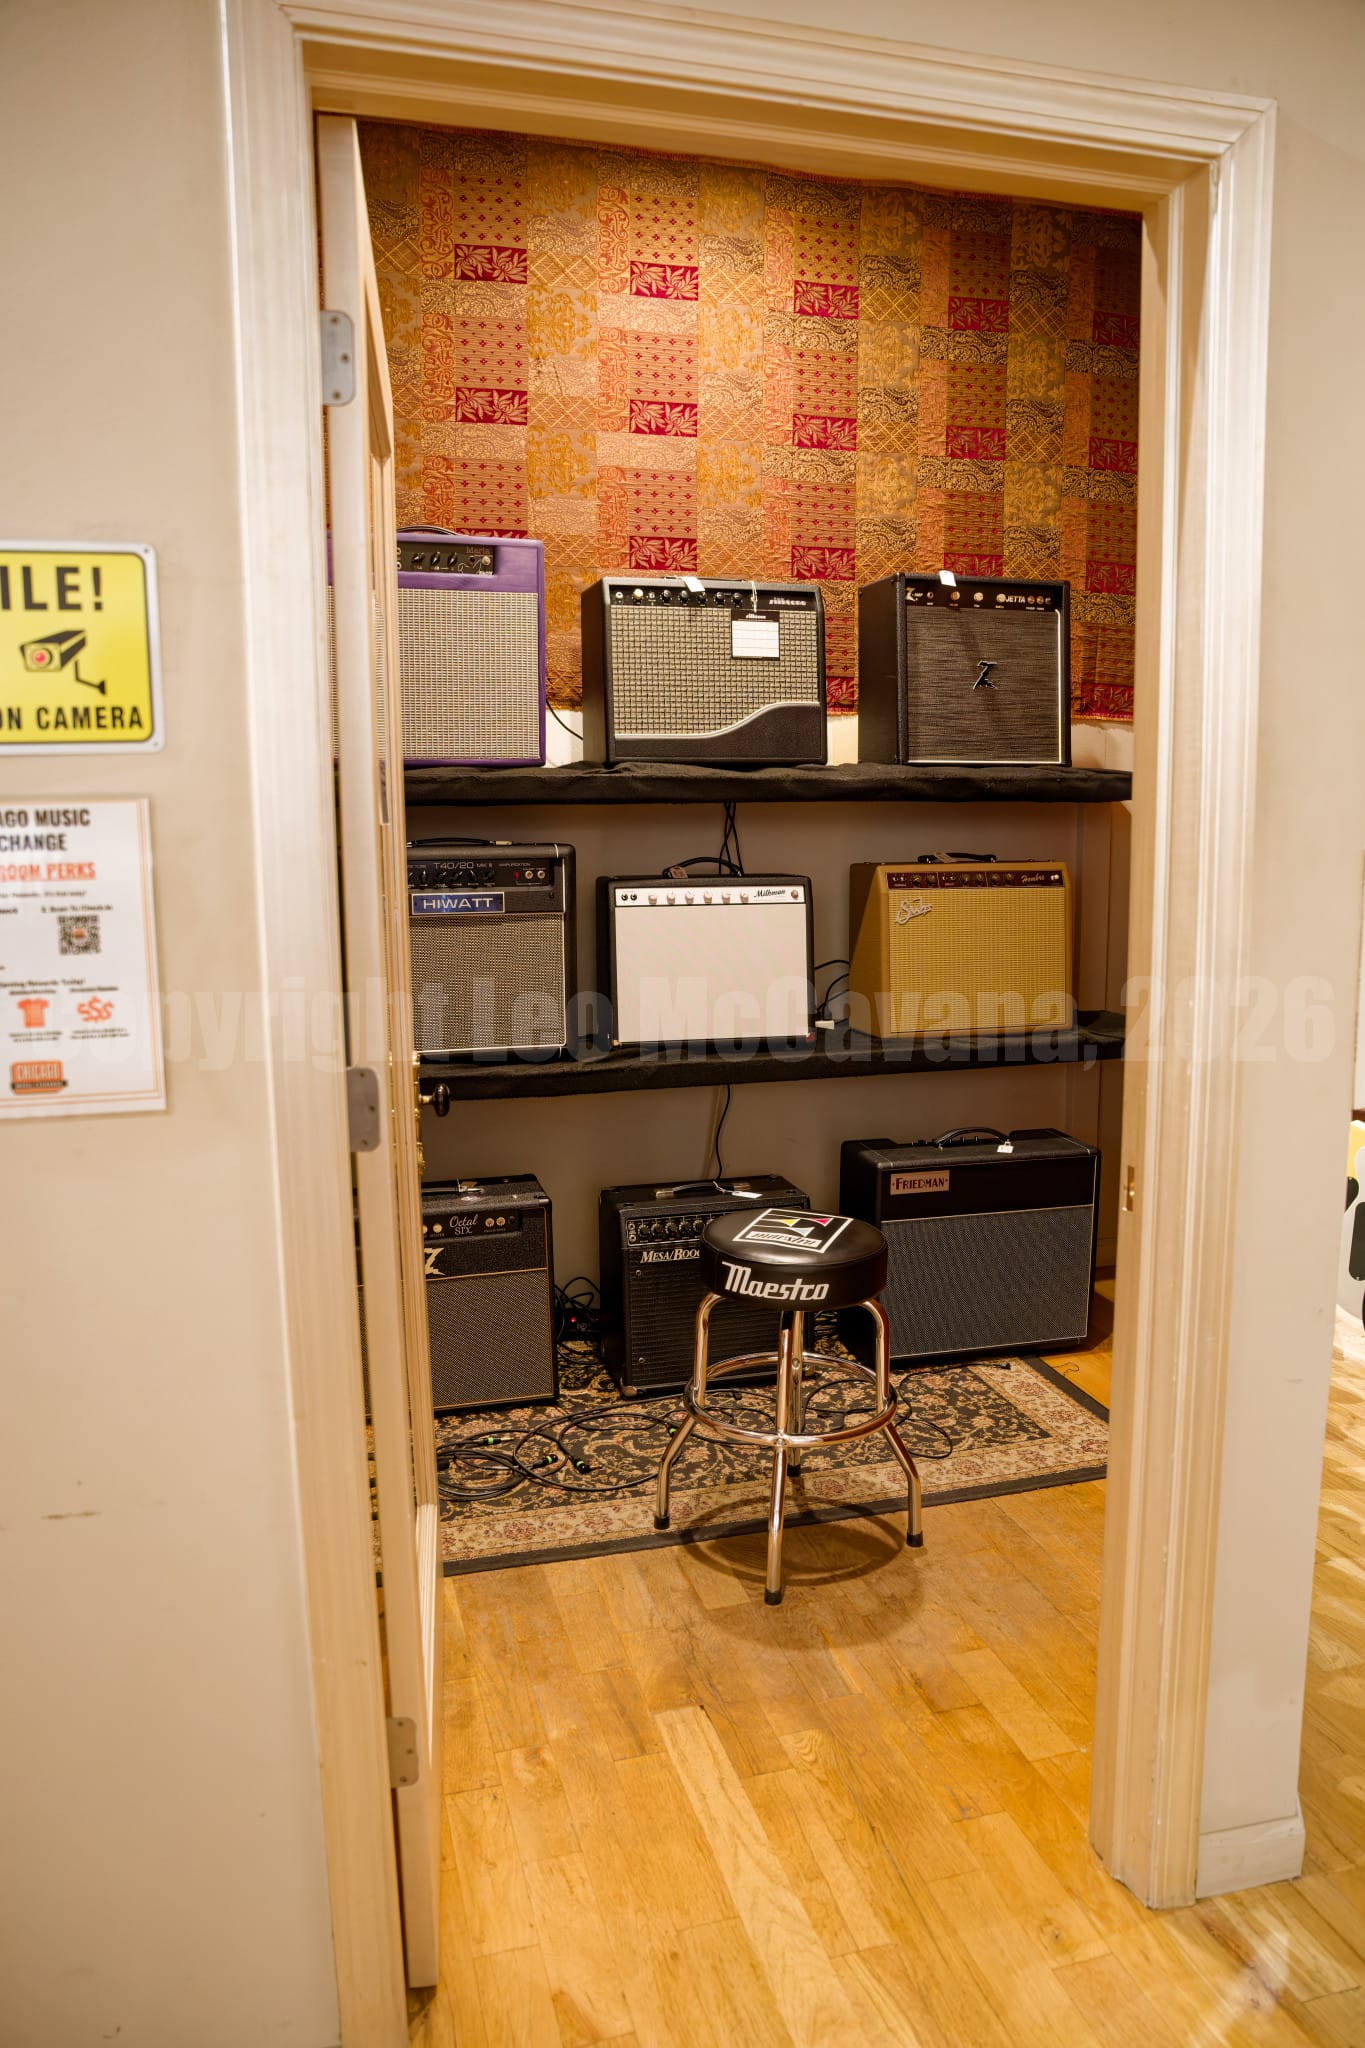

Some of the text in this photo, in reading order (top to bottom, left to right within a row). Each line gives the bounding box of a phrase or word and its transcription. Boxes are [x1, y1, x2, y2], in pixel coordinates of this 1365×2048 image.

[0, 705, 144, 731] N CAMERA
[35, 808, 91, 827] MUSIC
[47, 861, 97, 881] PERKS
[423, 898, 493, 909] HIWATT
[895, 1177, 945, 1190] FRIEDMAN
[449, 1213, 479, 1228] Octal
[722, 1261, 830, 1300] Maestro
